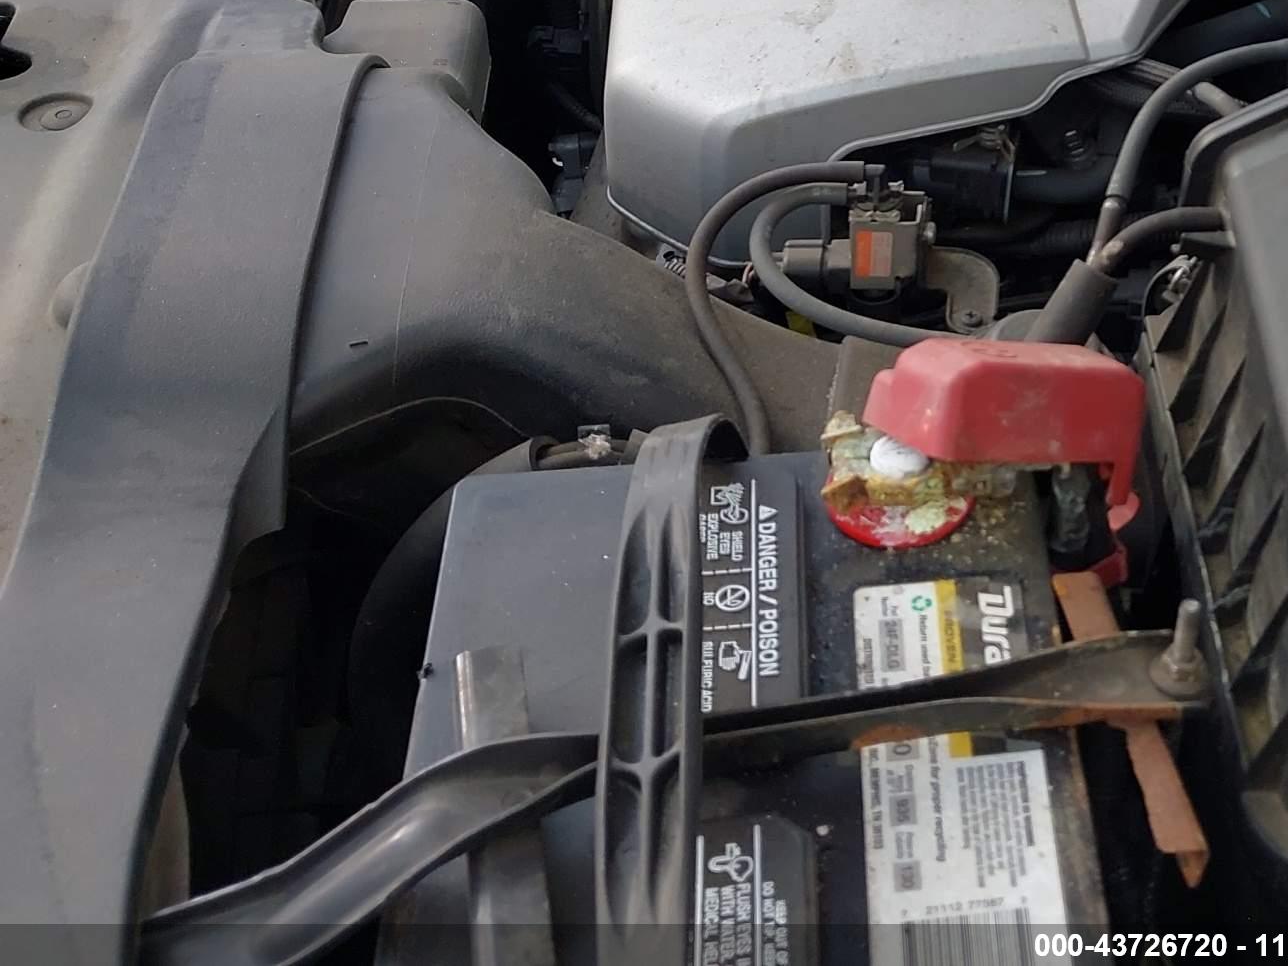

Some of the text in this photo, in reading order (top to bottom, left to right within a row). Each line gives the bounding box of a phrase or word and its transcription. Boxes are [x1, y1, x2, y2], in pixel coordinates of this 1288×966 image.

[707, 513, 719, 560] EXPLOSIVE
[719, 532, 730, 555] EYES
[732, 531, 743, 561] SHIELD
[757, 523, 776, 592] DANGER
[757, 609, 779, 677] POISON
[930, 766, 940, 780] for
[927, 781, 945, 814] proper
[704, 887, 719, 938] MEDICAL
[720, 884, 735, 916] WITH
[737, 882, 751, 921] FLUSH
[737, 924, 751, 954] EYES
